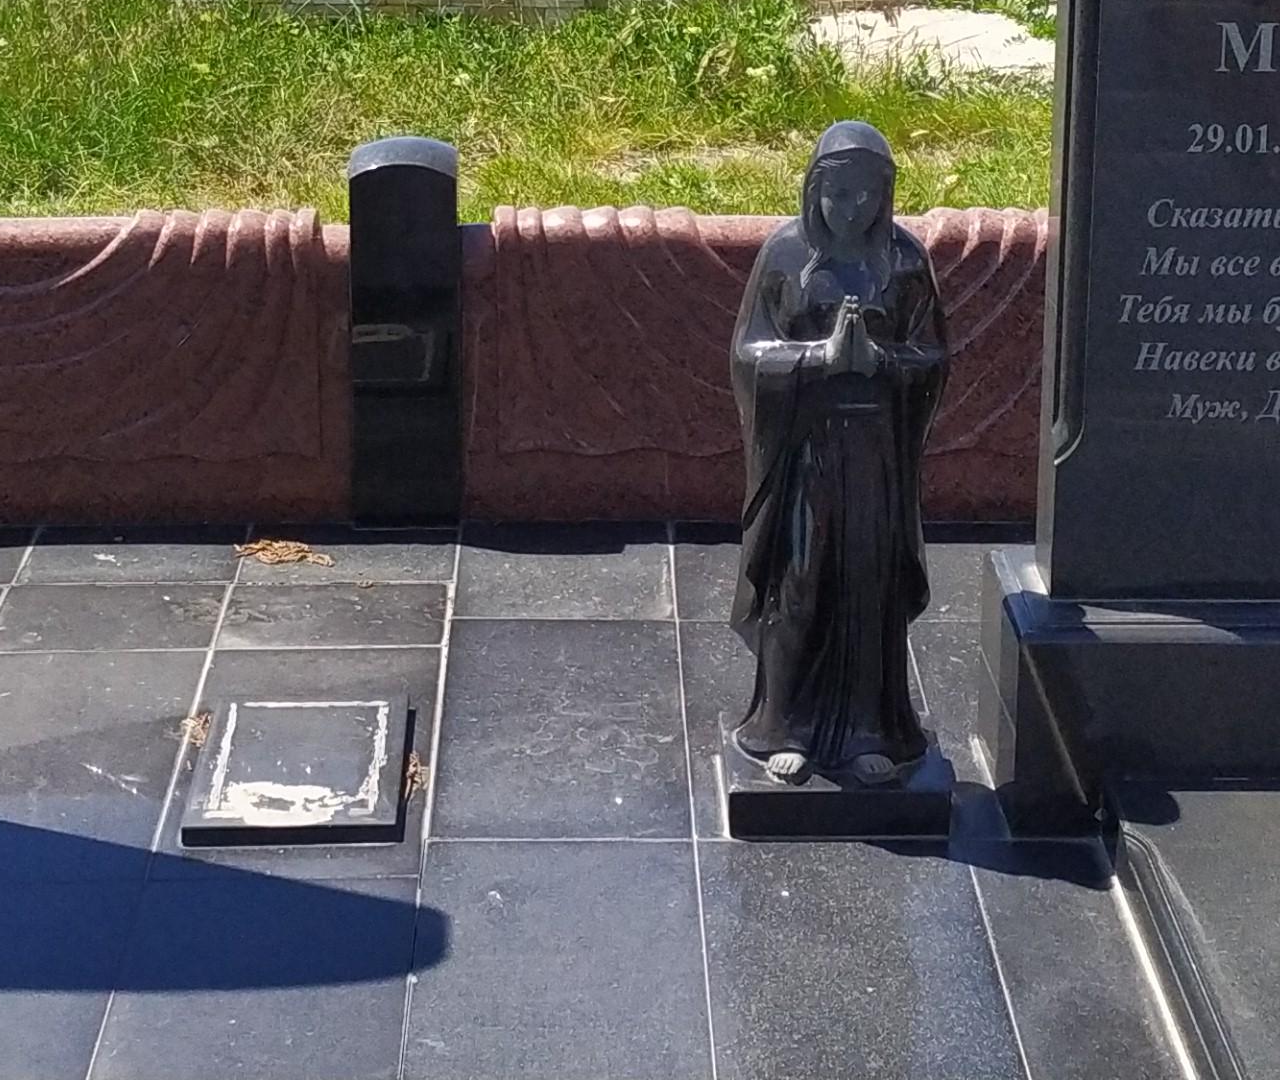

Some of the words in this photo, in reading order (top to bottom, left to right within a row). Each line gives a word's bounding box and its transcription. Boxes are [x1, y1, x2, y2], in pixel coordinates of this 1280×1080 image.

[1140, 247, 1200, 276] Мы
[1211, 255, 1258, 276] все
[1118, 294, 1189, 324] Тебя
[1198, 304, 1251, 323] мы
[1134, 342, 1256, 371] Навеки
[1266, 351, 1280, 371] в
[1168, 394, 1249, 425] Муж,
